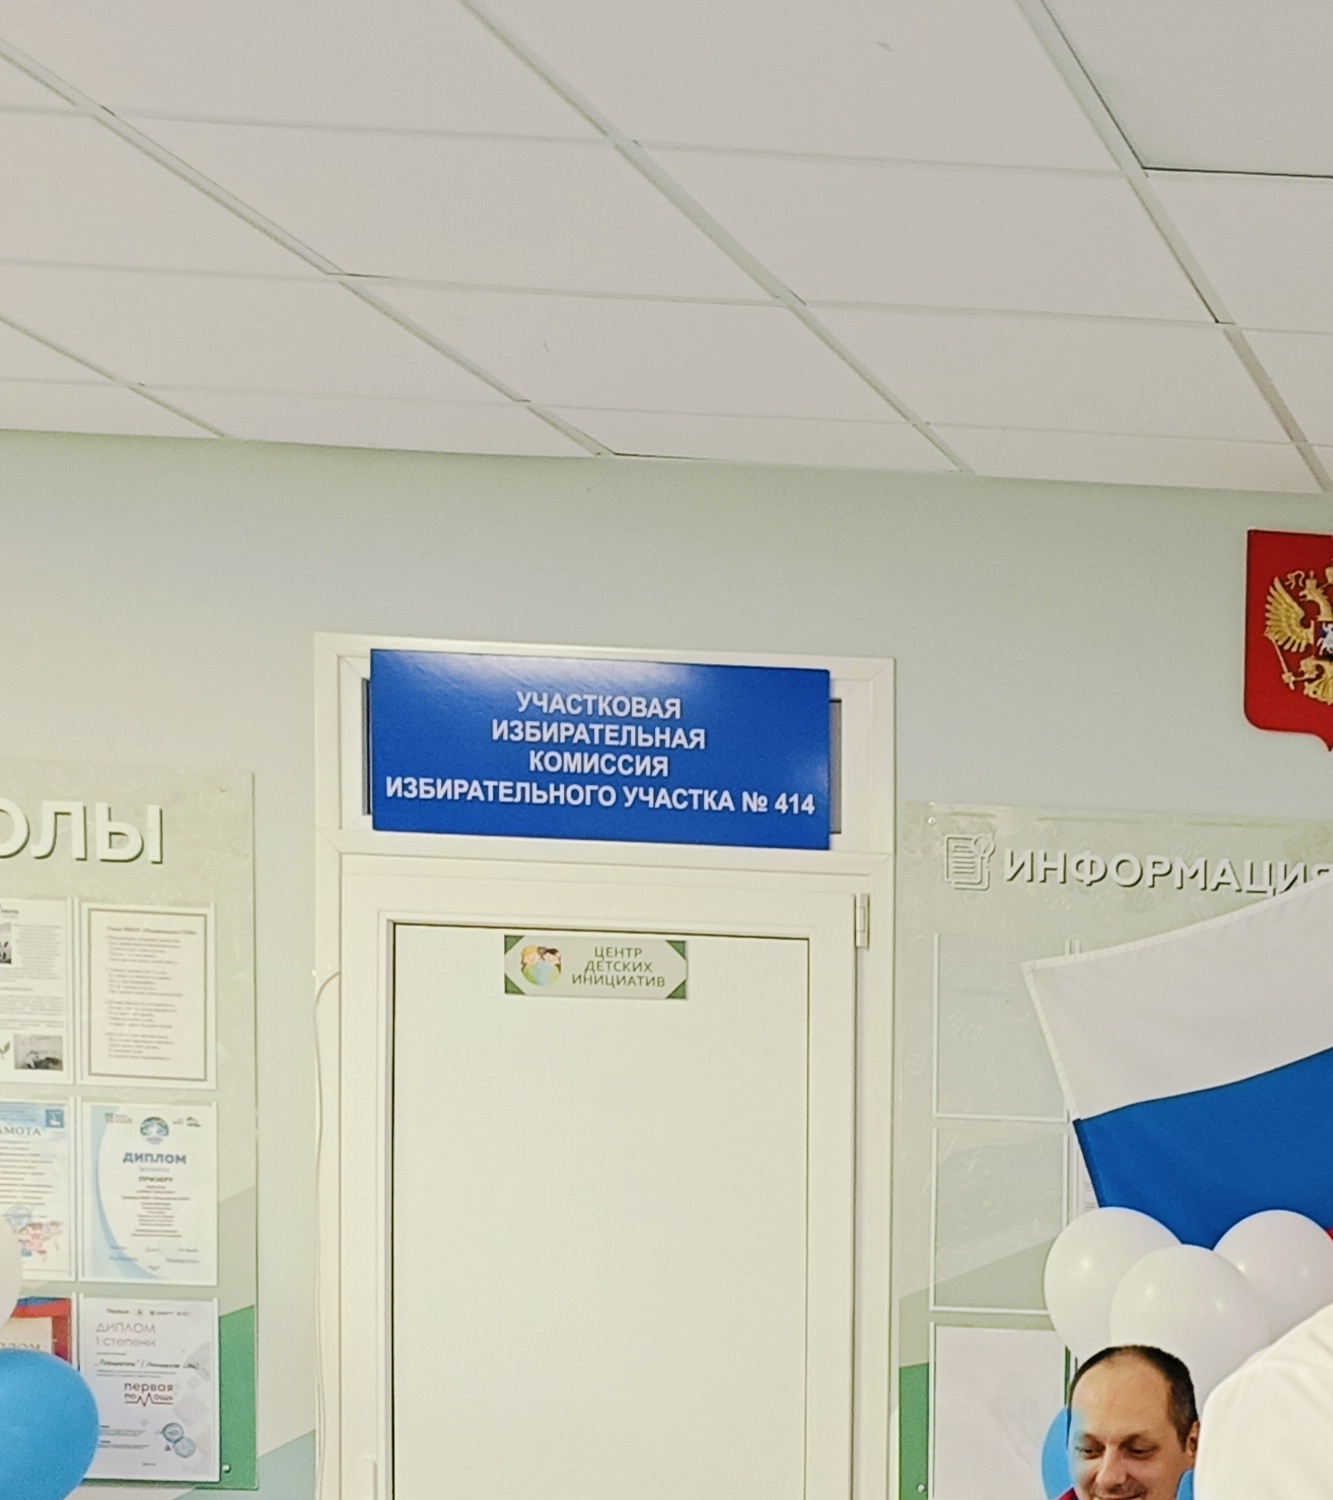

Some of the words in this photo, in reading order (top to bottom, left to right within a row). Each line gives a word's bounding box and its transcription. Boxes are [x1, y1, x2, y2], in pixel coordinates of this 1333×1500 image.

[517, 691, 681, 719] УЧАСТКОВАЯ
[492, 718, 705, 749] ИЗБИРАТЕЛЬНАЯ
[529, 750, 668, 777] КОМИССИЯ
[386, 776, 616, 807] ИЗБИРАТЕЛЬНОГО
[623, 785, 735, 812] УЧАСТКА
[742, 791, 768, 813] №
[774, 792, 815, 815] 414
[594, 946, 642, 960] ЦЕНТР
[584, 960, 653, 974] ДЕТСКИХ
[572, 974, 665, 989] ИНИЦИАТИВ
[123, 1152, 186, 1164] ДИПЛОМ
[95, 1322, 155, 1334] ДИПЛОМ
[124, 1382, 174, 1393] первая
